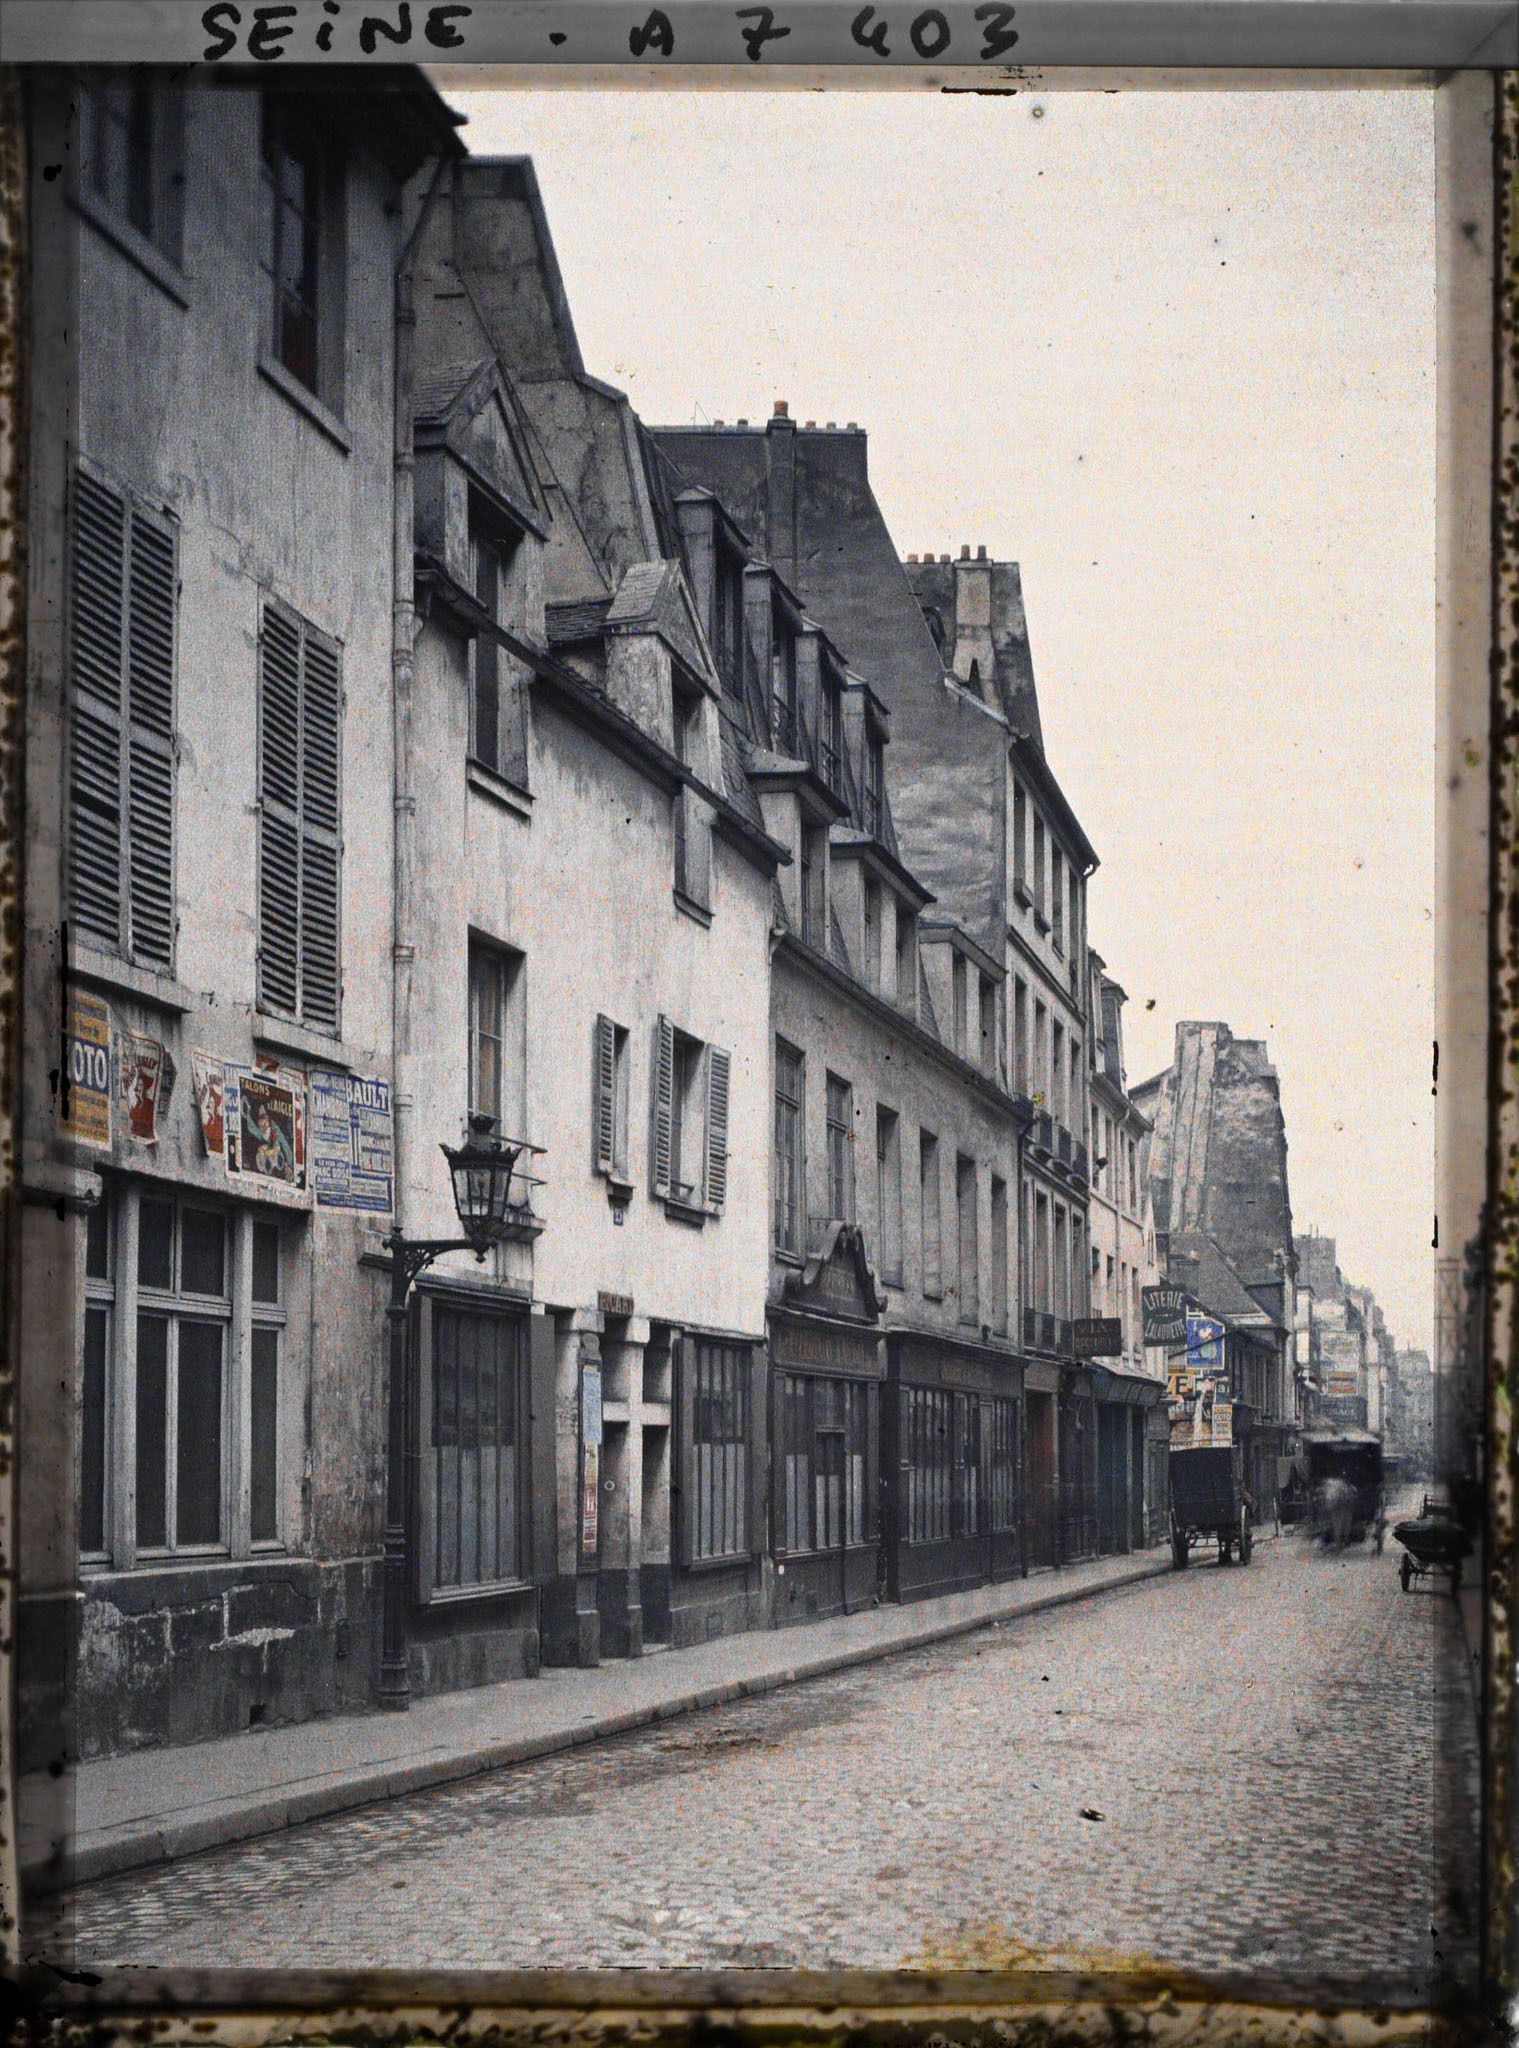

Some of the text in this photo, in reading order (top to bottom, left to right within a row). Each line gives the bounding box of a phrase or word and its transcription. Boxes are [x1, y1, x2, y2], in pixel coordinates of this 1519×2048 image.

[629, 9, 674, 56] A
[735, 8, 791, 61] 7
[240, 1078, 270, 1096] TALONS
[346, 1079, 388, 1111] BAULT
[1143, 1291, 1184, 1311] LITERIE
